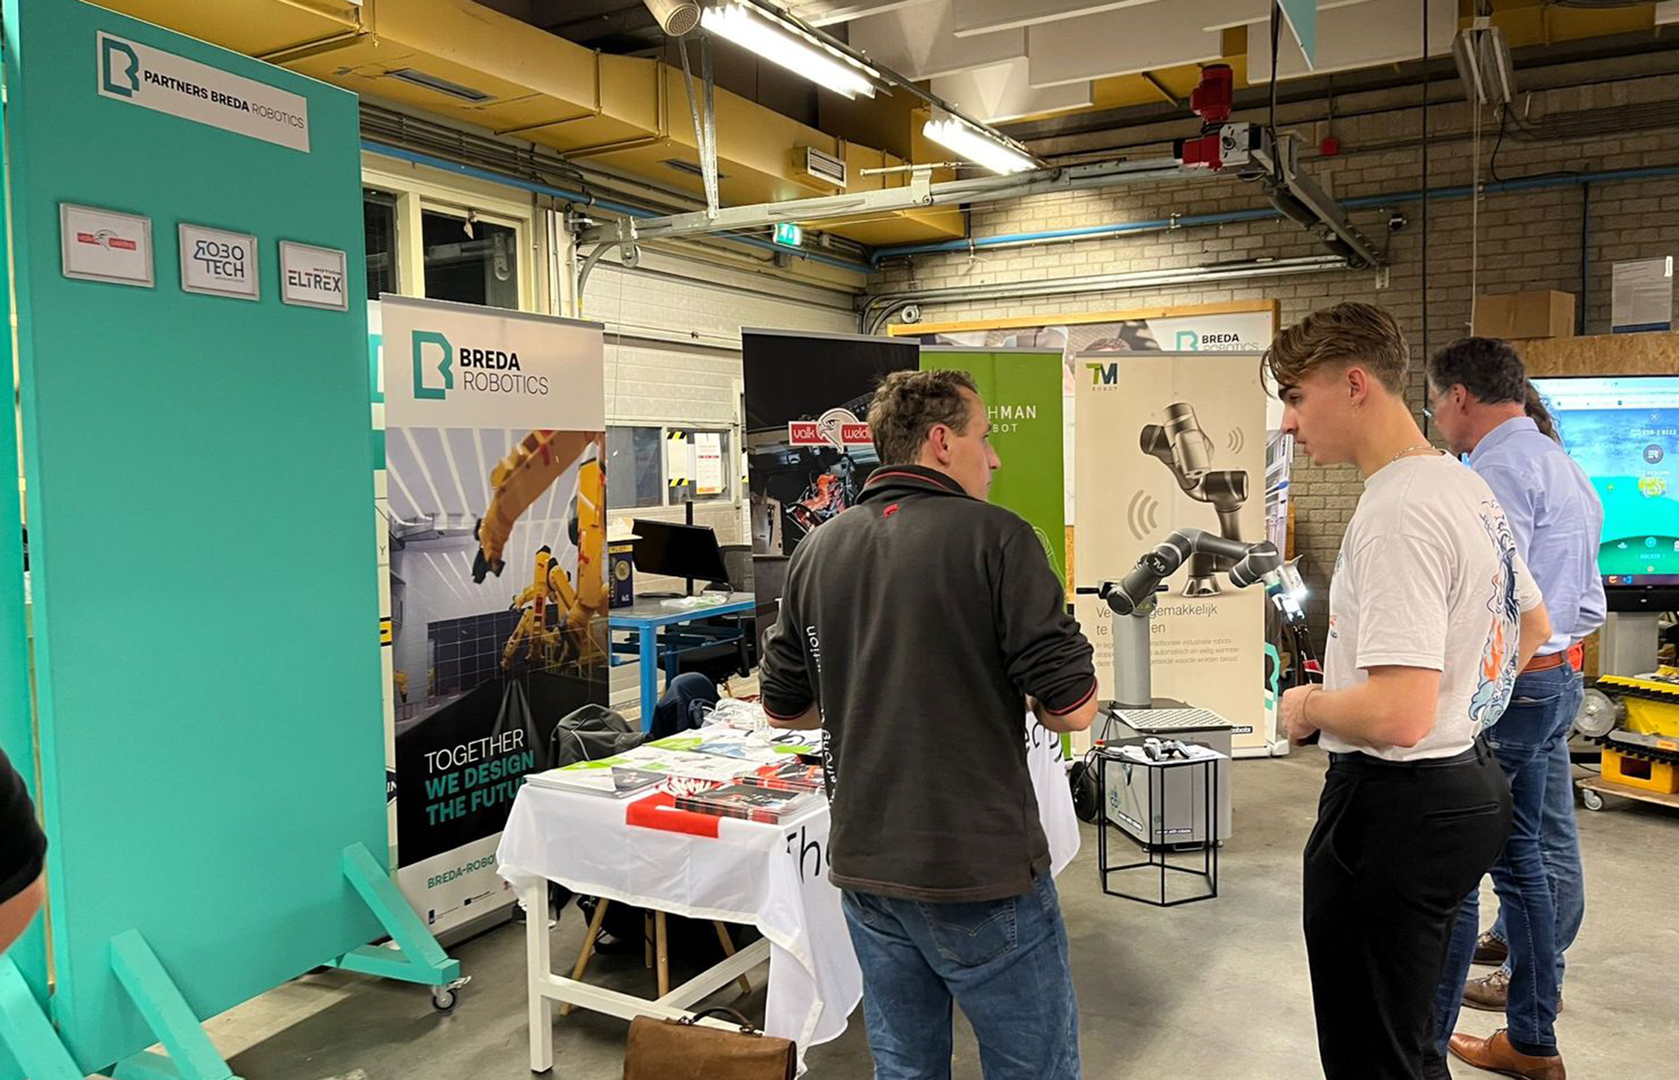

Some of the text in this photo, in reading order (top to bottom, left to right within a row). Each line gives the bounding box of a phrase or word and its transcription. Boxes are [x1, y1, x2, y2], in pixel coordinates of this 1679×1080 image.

[144, 70, 304, 129] PARTNERS BREDA ROBOTICS
[206, 259, 244, 278] TECH
[288, 270, 342, 293] ELTREX
[1202, 333, 1240, 344] BREDA
[460, 348, 521, 371] BREDA
[464, 371, 549, 395] ROBOTICS
[1085, 363, 1117, 384] TM
[986, 405, 1037, 420] HMAN
[793, 427, 815, 439] valk
[992, 423, 1018, 433] BOT
[1096, 625, 1108, 636] te
[424, 728, 524, 774] TOGETHER
[425, 749, 535, 800] WE DESIGN
[426, 777, 527, 826] THE FUTU
[428, 853, 497, 889] BREDA-ROBO
